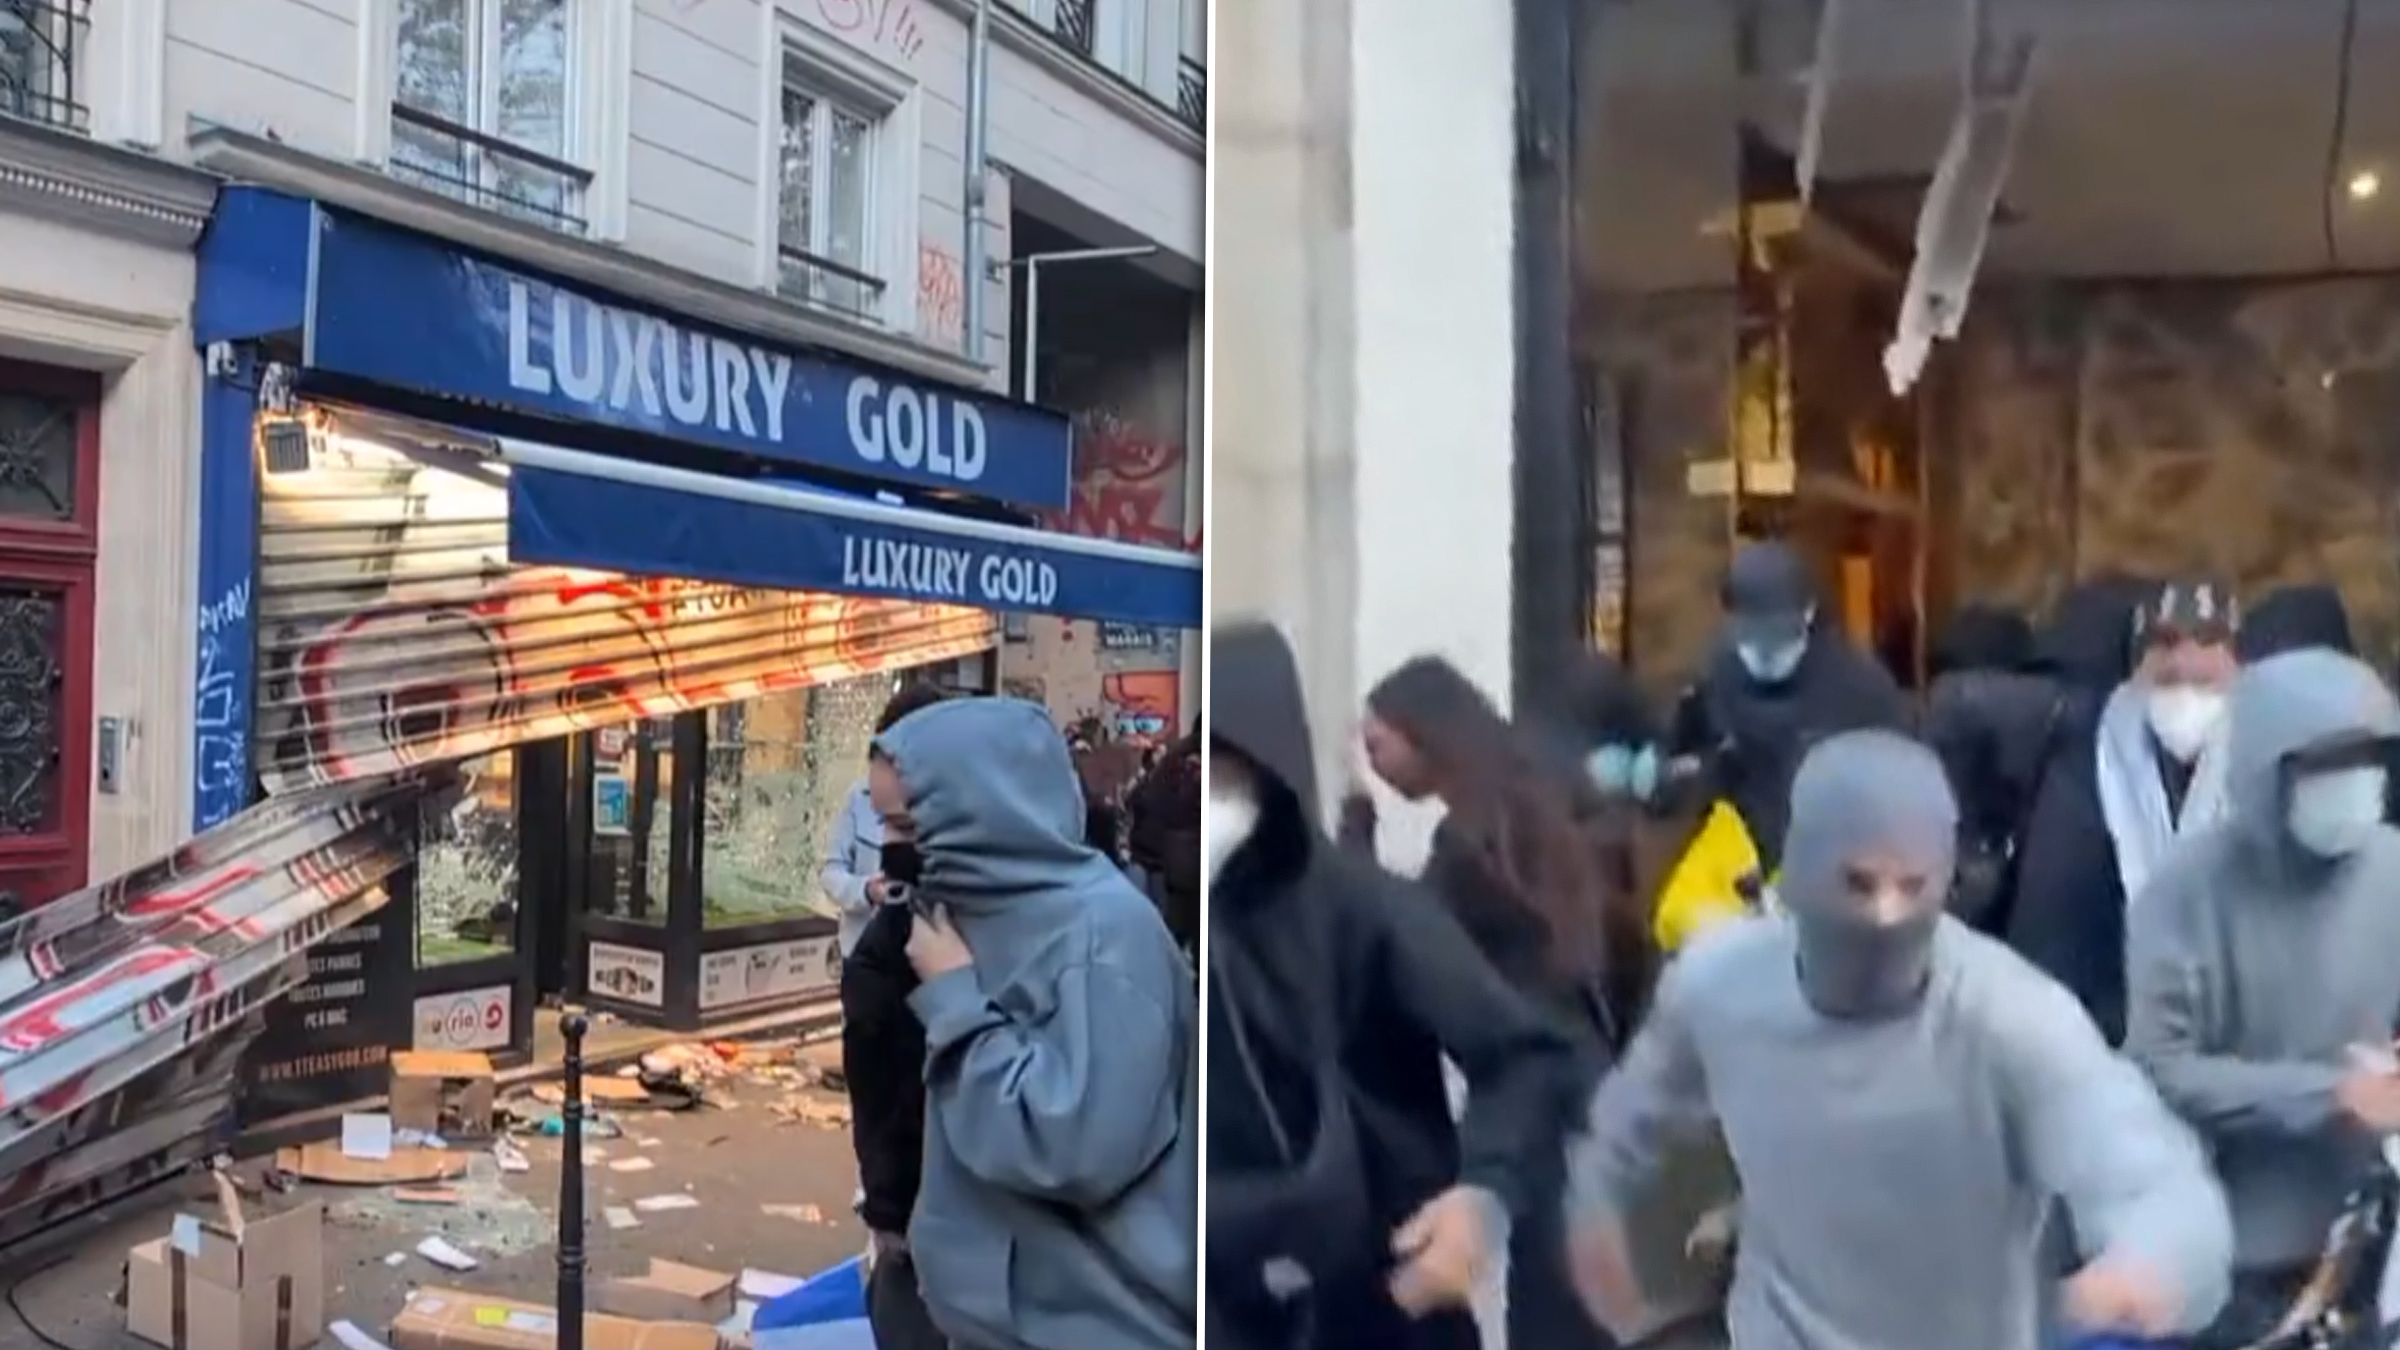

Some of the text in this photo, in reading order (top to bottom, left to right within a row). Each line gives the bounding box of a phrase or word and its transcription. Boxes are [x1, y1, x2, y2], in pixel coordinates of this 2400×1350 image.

[510, 281, 791, 442] LUXURY
[847, 376, 986, 481] GOLD
[843, 535, 1057, 606] LUXURY GOLD
